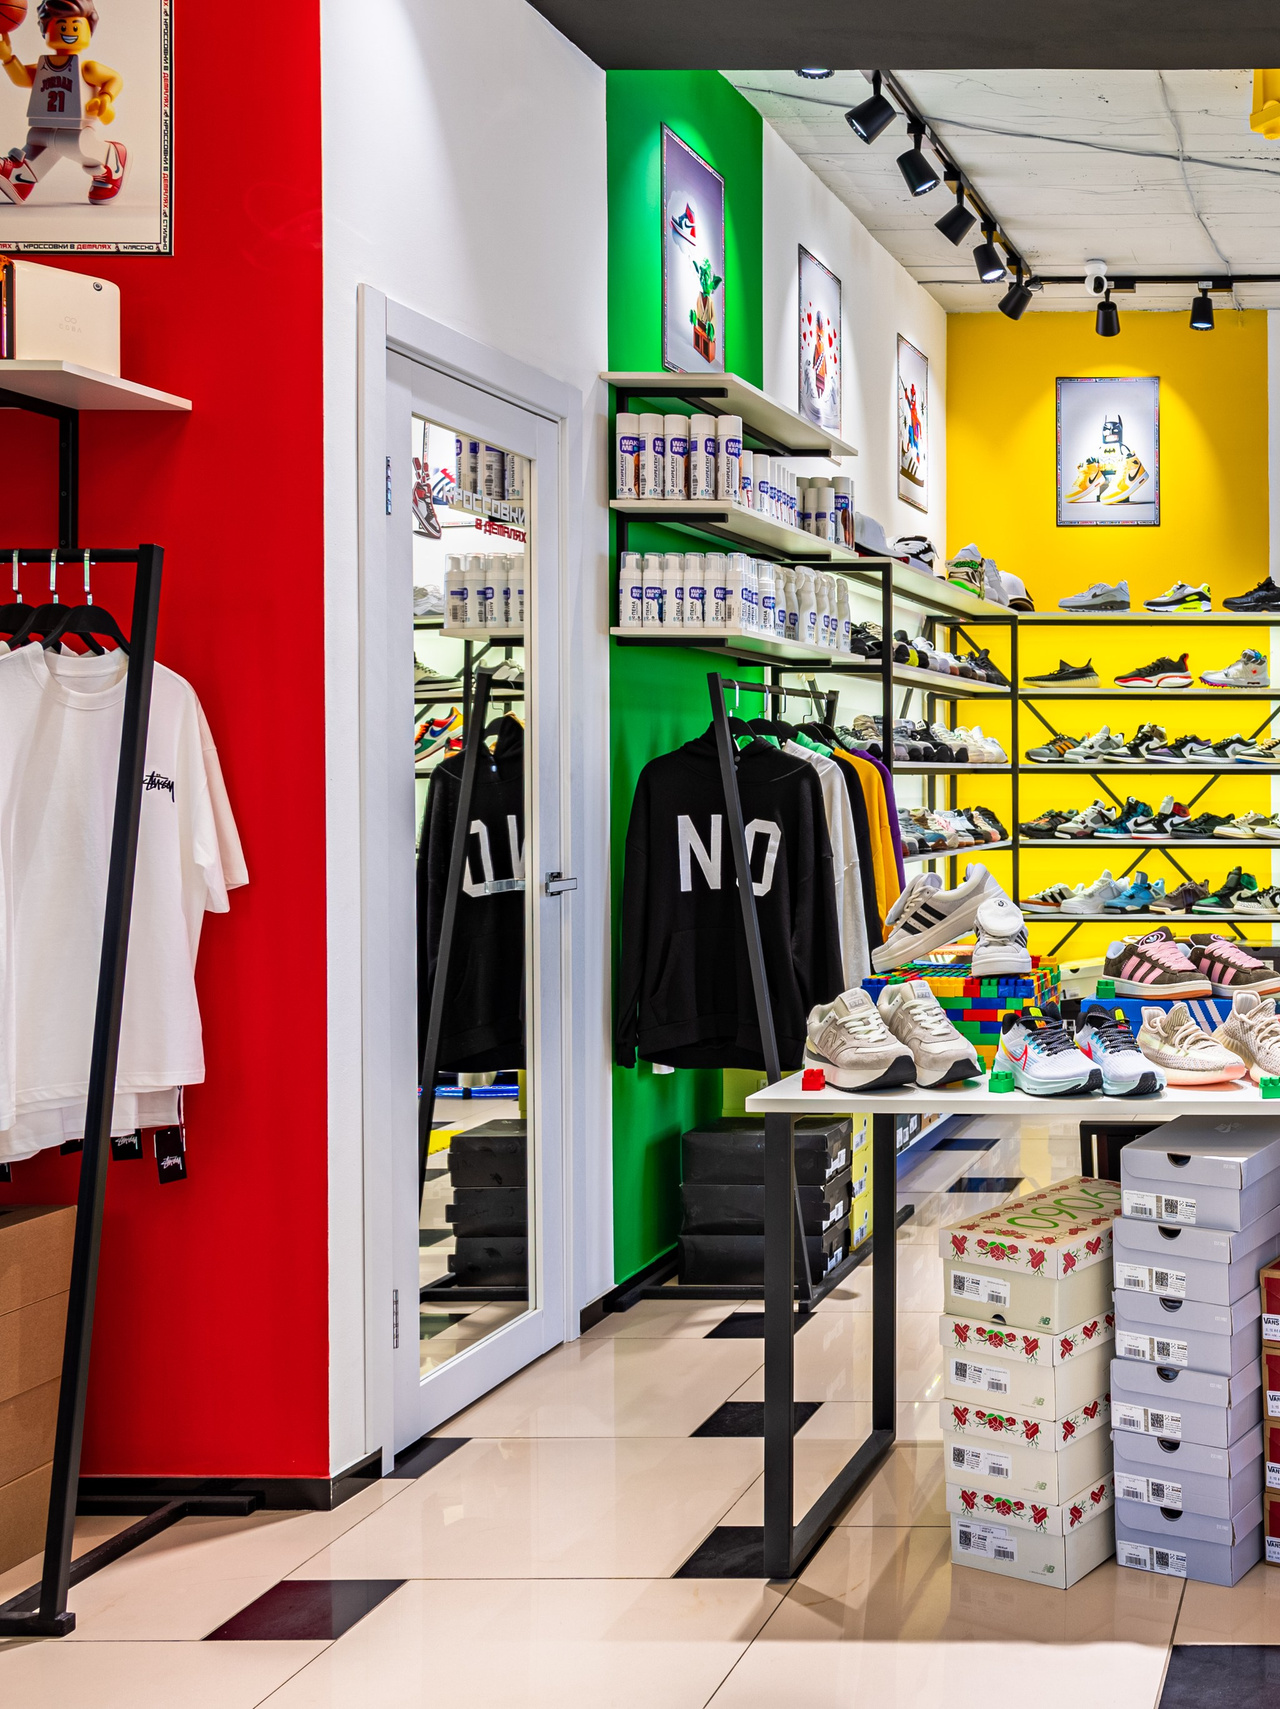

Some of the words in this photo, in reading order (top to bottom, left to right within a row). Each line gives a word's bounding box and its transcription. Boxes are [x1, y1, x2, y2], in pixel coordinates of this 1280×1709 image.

[47, 91, 65, 112] 21
[677, 814, 781, 897] NO
[1263, 1317, 1279, 1326] VANS
